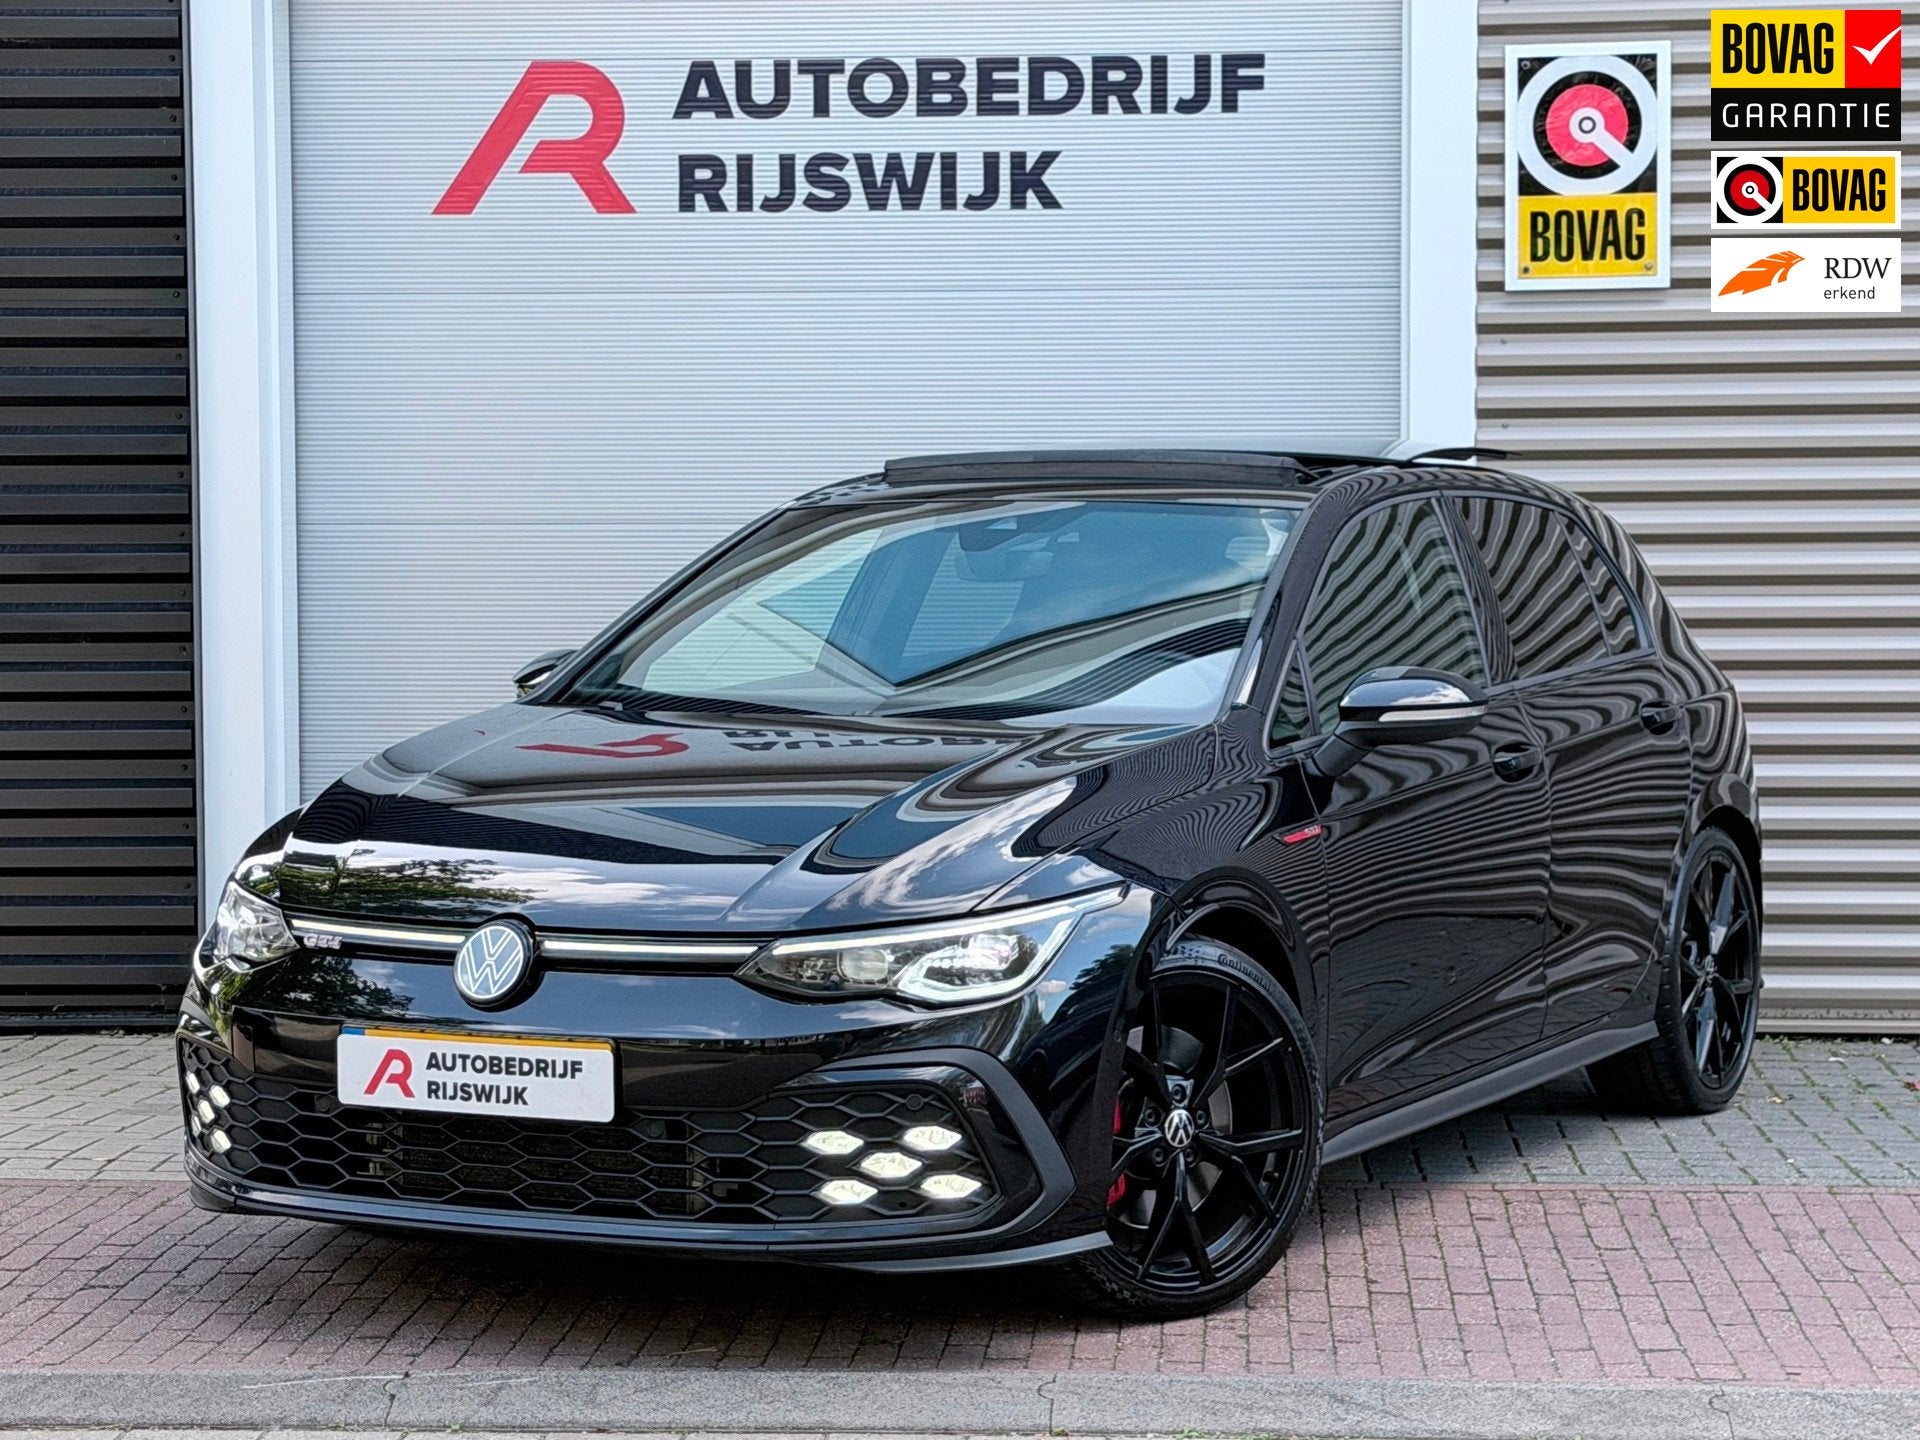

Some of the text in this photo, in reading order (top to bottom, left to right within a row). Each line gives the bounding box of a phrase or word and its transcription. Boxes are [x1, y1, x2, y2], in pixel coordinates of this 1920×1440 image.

[672, 53, 1265, 120] AUTOBEDRIJF
[678, 150, 1063, 213] RIJSWIJK
[1530, 208, 1646, 262] BOVAG
[303, 934, 342, 950] GTI
[1217, 953, 1272, 993] Continental
[425, 1051, 584, 1080] AUTOBEDRIJF
[427, 1080, 529, 1106] RIJSWIJK
